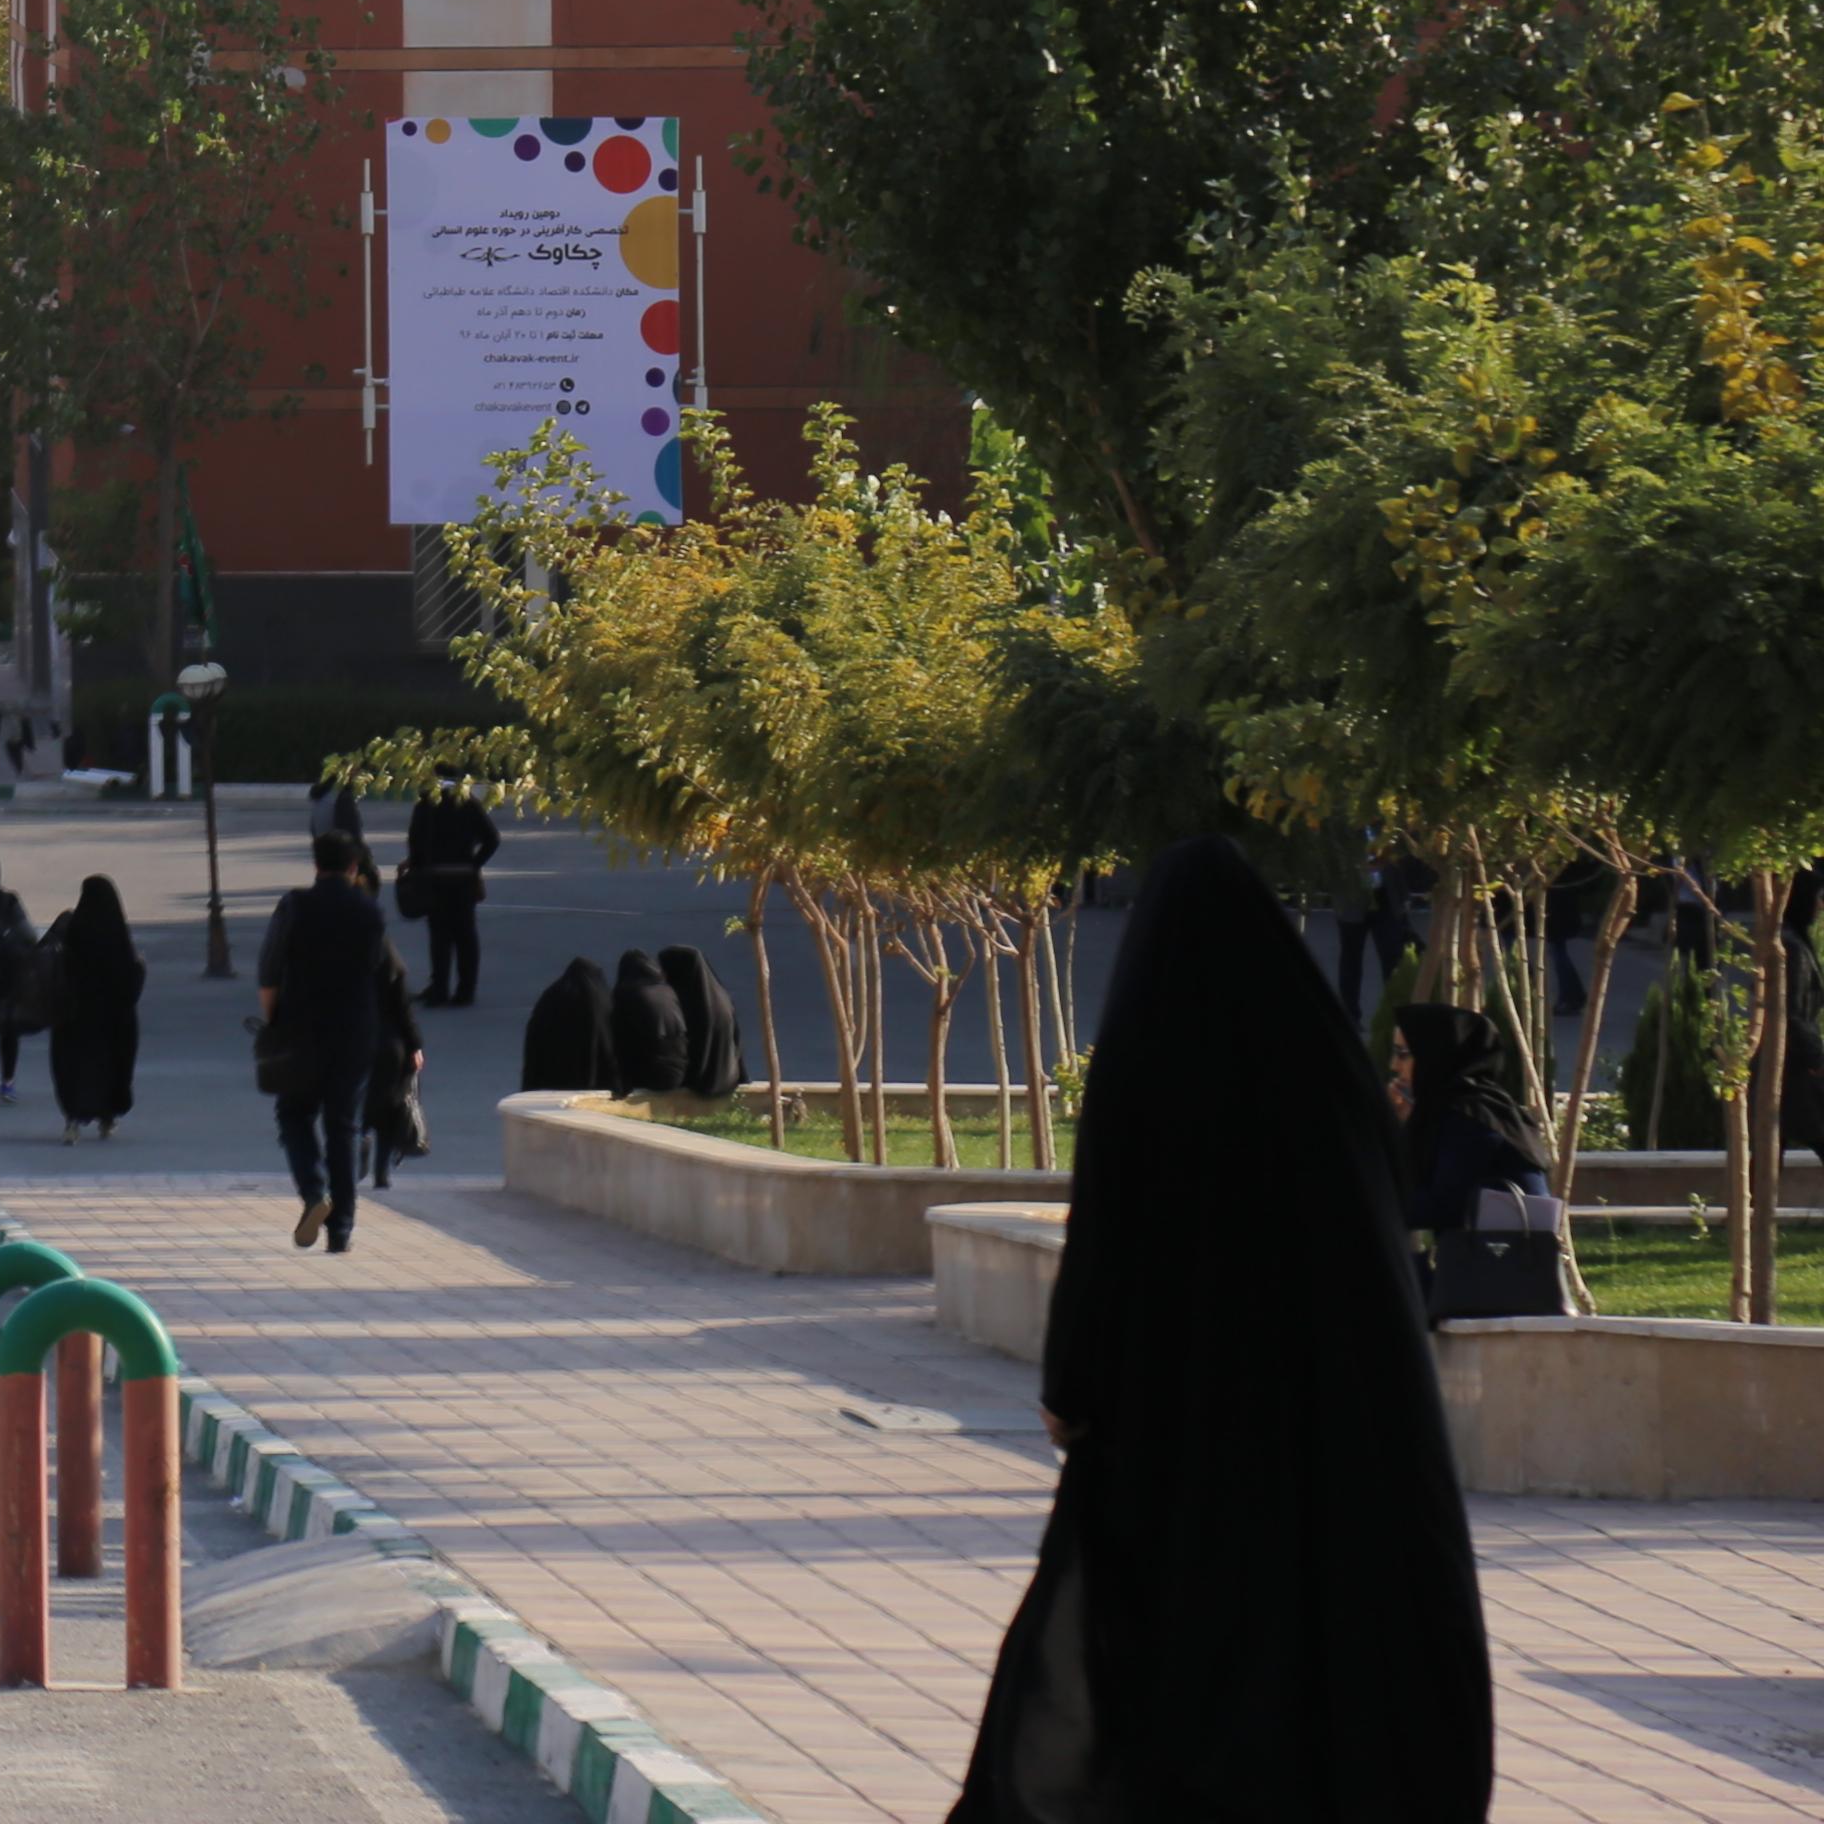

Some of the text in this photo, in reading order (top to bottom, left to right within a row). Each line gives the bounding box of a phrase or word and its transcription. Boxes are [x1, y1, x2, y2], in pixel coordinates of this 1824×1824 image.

[499, 209, 561, 221] دومین رویداد
[431, 223, 629, 239] تخصصی کارآفرینی در حوزه علوم انسانی
[527, 243, 603, 271] چکاوک
[468, 286, 495, 297] علامه
[496, 284, 536, 297] دانشگاه
[538, 285, 571, 297] اقتصاد
[572, 285, 614, 297] دانشکده
[615, 286, 640, 298] مکان
[476, 306, 587, 320] زمان دوم تا دهم آذر ماه
[473, 329, 490, 340] ماه
[492, 328, 512, 343] آبان
[545, 329, 560, 342] نام
[560, 328, 577, 341] ثبت
[577, 329, 605, 341] مهلت
[483, 353, 580, 364] chakavak-event.ir
[473, 400, 553, 413] chakavakevent
